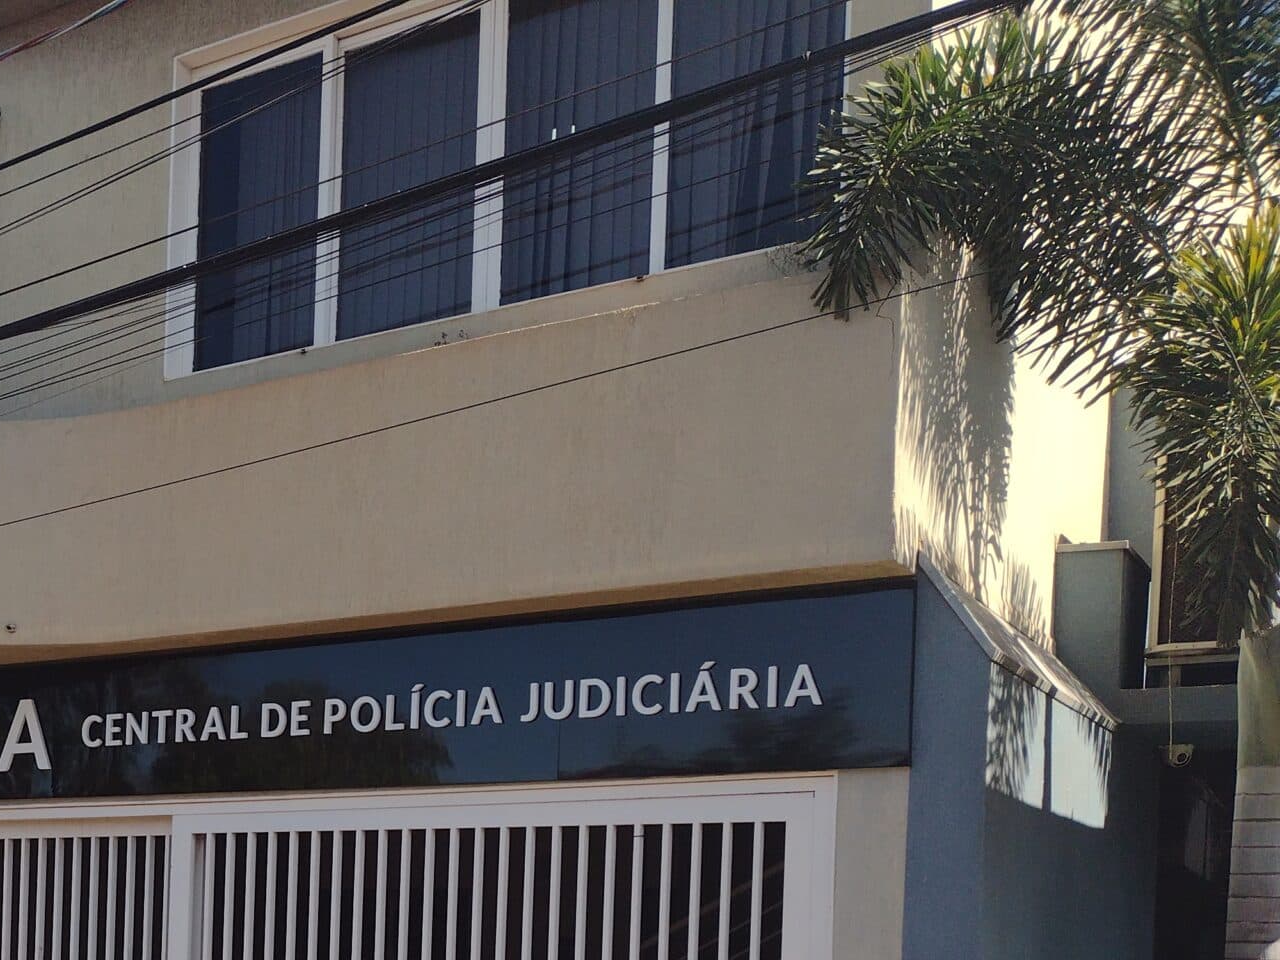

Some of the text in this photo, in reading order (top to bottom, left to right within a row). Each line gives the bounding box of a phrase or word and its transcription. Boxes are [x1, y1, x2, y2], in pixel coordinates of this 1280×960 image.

[81, 704, 249, 748] CENTRAL
[260, 700, 312, 738] DE
[323, 683, 503, 734] POLÍCIA
[520, 661, 823, 722] JUDICIÁRIA
